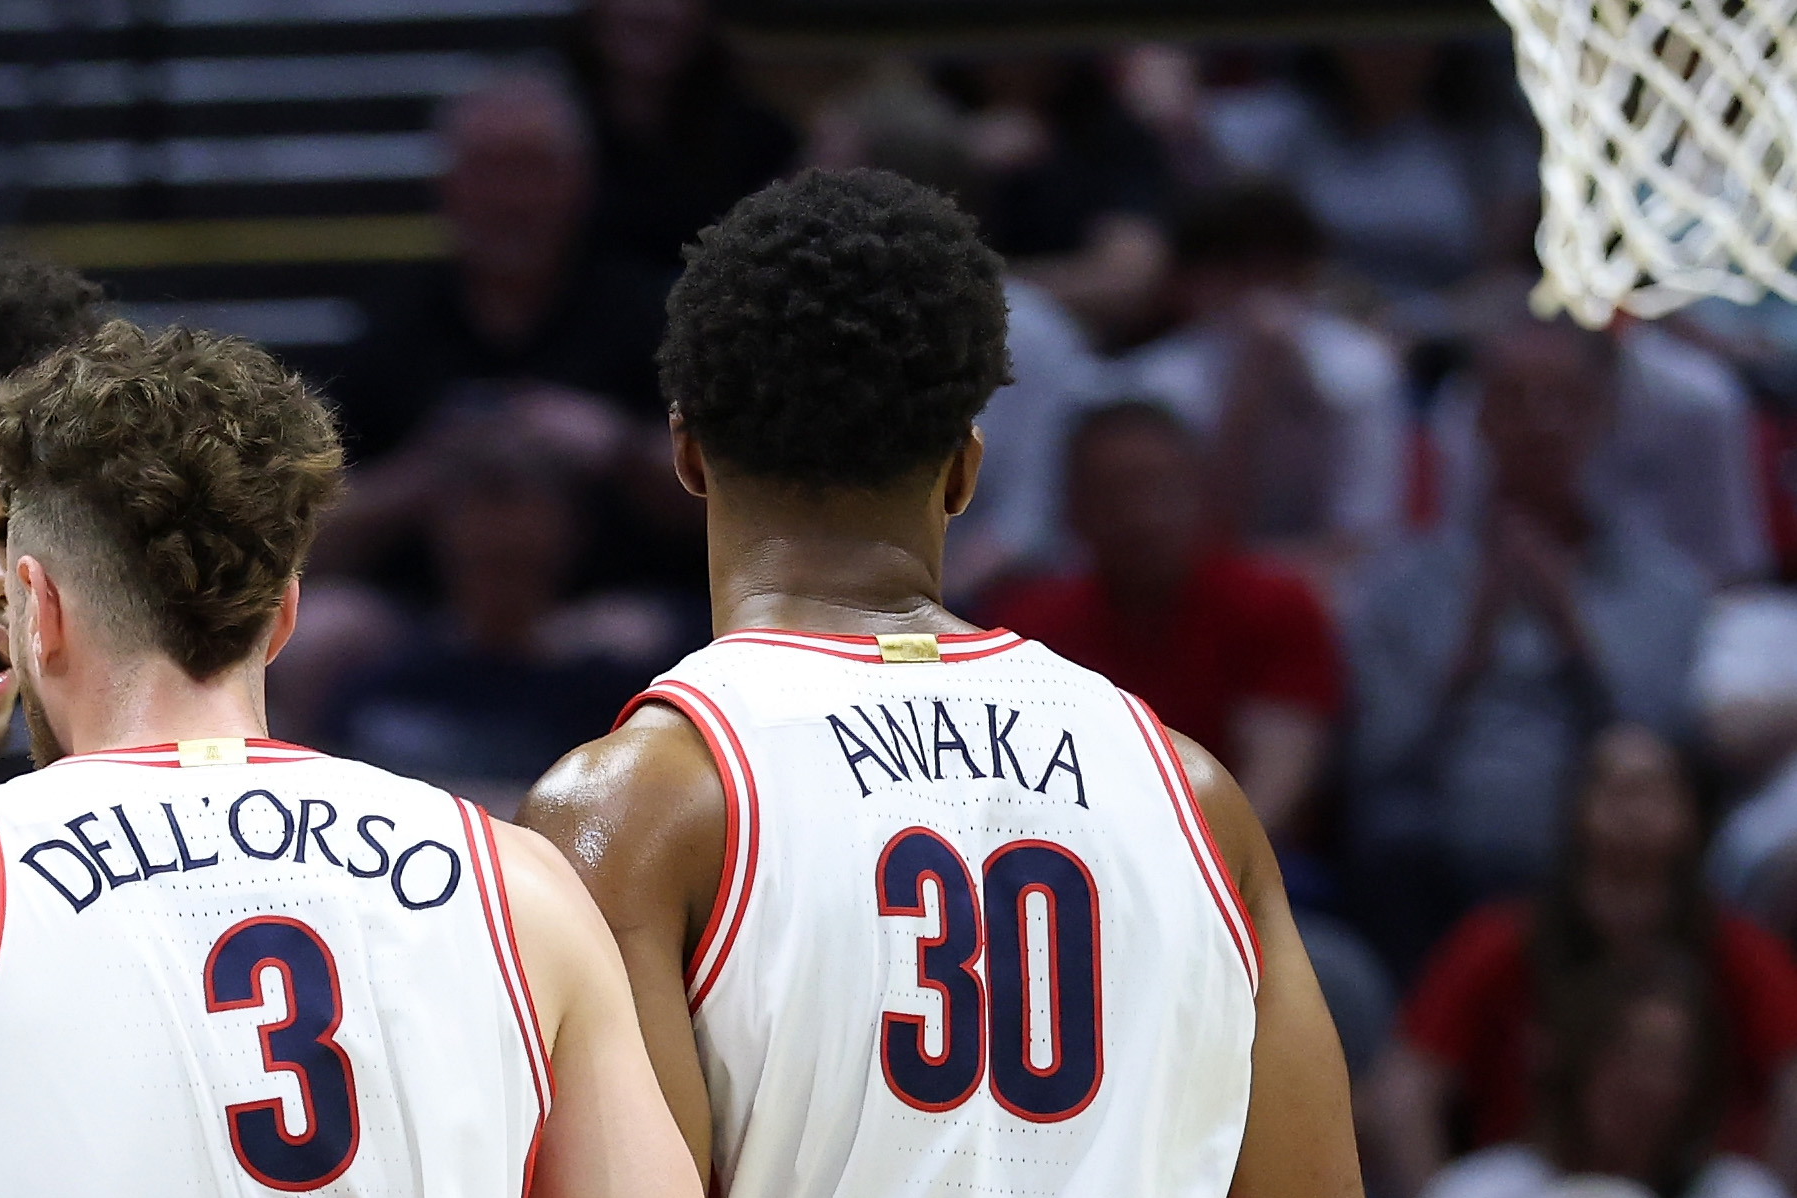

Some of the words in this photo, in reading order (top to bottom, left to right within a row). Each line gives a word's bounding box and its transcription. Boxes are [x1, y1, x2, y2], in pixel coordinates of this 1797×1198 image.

[19, 789, 462, 914] DELL'ORSO
[826, 700, 1089, 810] AWAKA
[203, 914, 361, 1193] 3
[875, 825, 1105, 1124] 30
